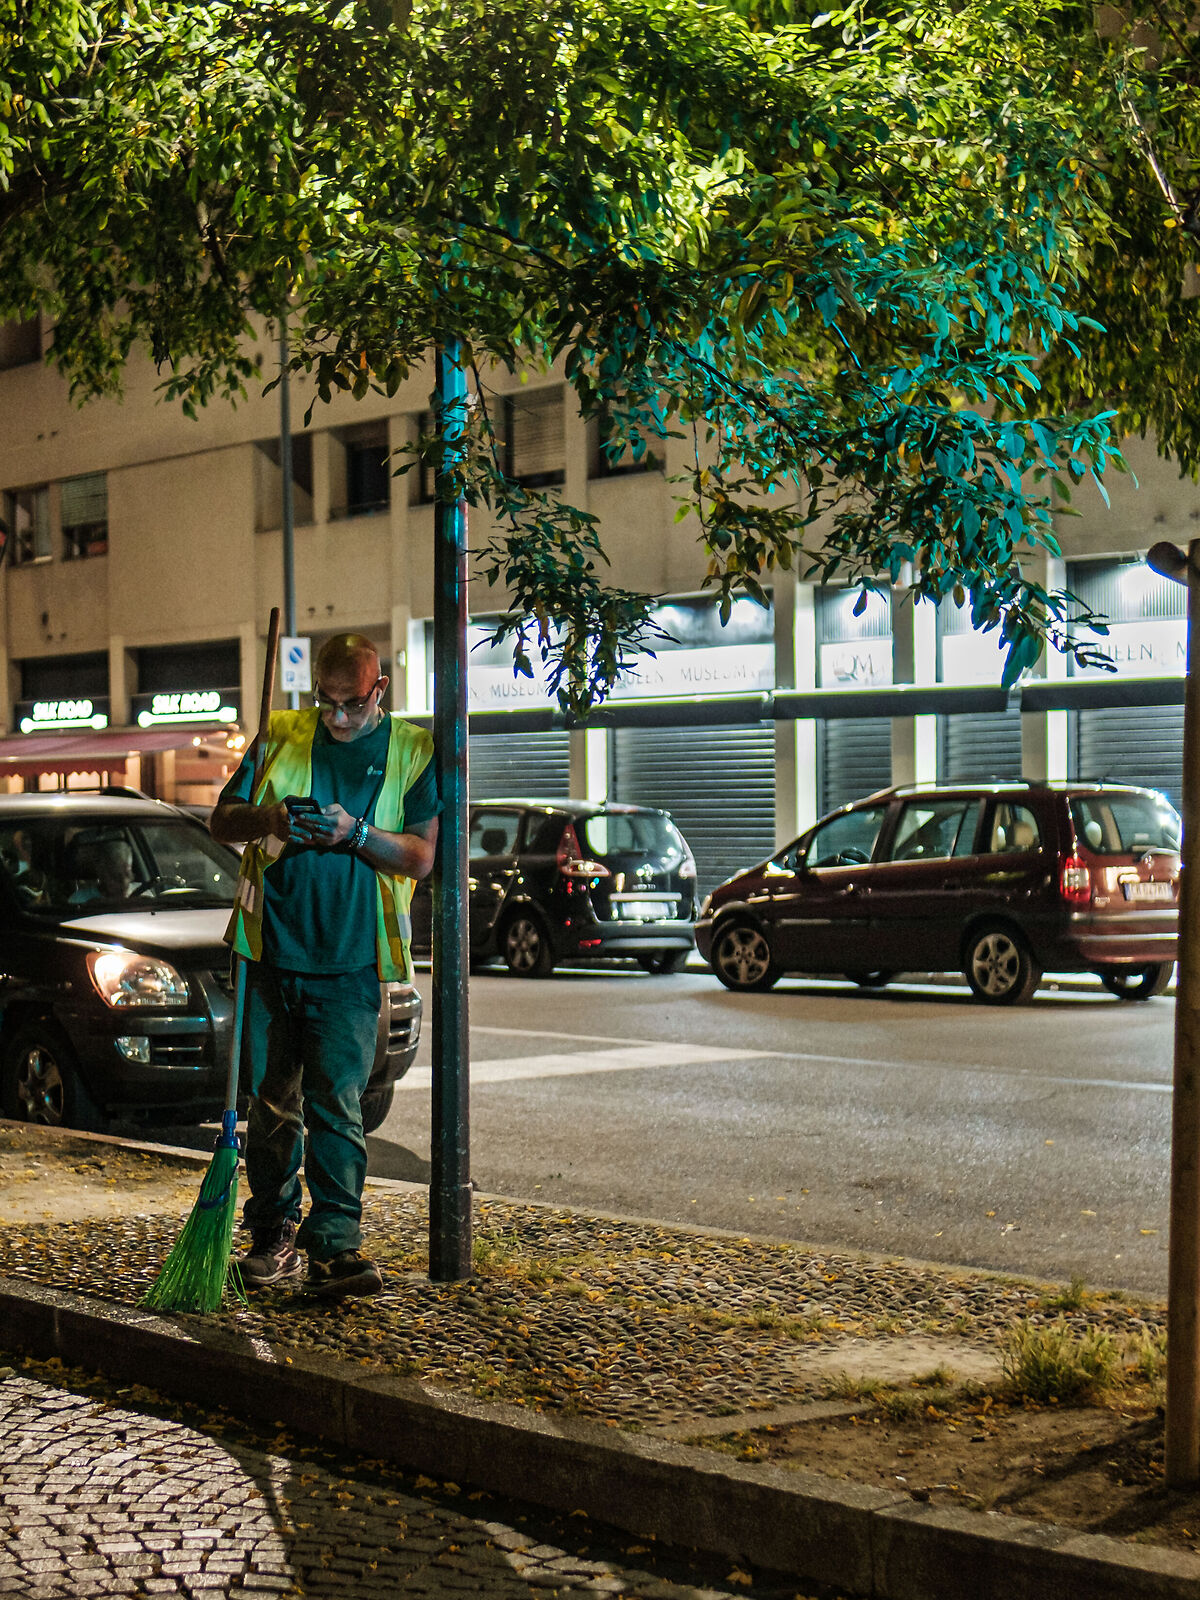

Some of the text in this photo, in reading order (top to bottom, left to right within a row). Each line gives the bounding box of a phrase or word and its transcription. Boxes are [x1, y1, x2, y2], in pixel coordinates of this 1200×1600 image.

[33, 700, 93, 720] SILK ROAD
[152, 692, 220, 714] SILK ROAD
